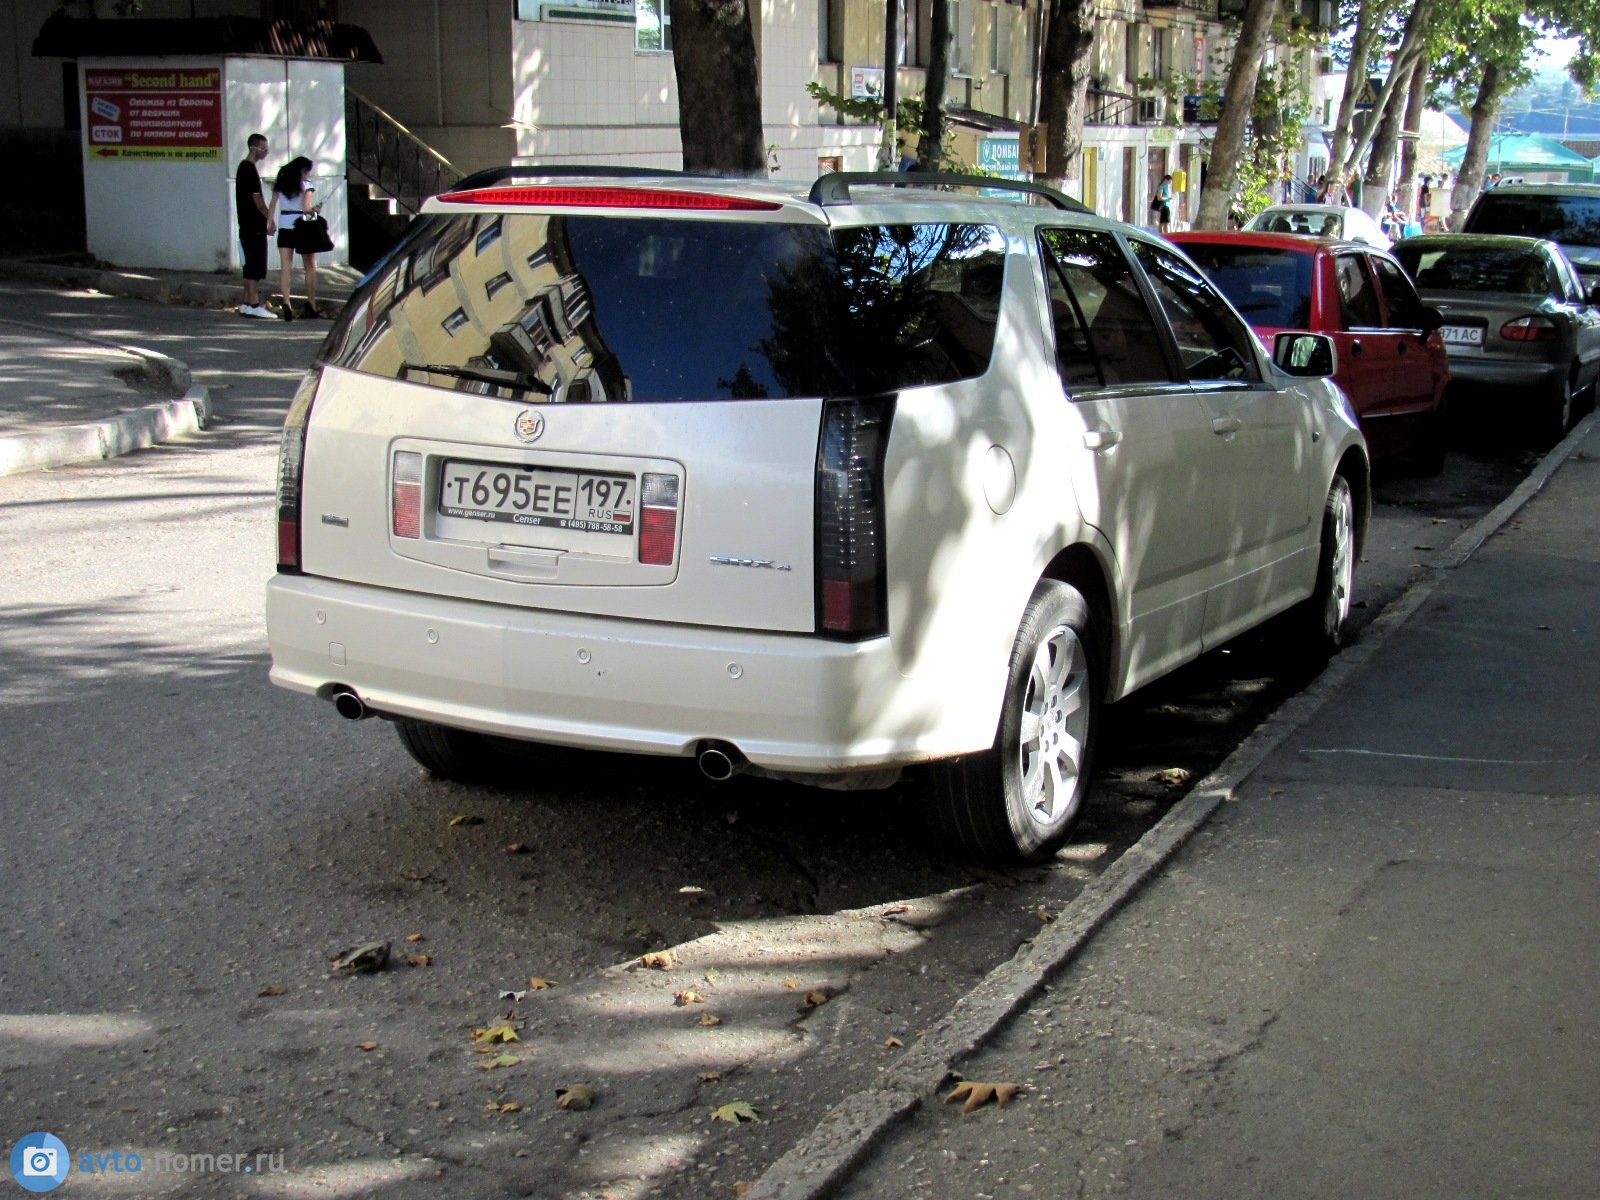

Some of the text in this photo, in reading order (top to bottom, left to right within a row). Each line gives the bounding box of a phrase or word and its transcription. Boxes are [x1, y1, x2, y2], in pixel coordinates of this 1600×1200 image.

[129, 98, 214, 107] Одежда из Европы
[129, 109, 181, 118] от ведущих
[130, 119, 202, 129] производителей
[94, 129, 120, 138] СТОК
[178, 131, 208, 139] ценам
[122, 149, 166, 158] Качественно
[1461, 328, 1478, 341] AC
[581, 478, 628, 509] 197
[588, 508, 612, 520] RUS
[447, 507, 496, 519] www.genser.ru
[568, 520, 587, 530] (495)
[588, 521, 623, 532] 788-58-58
